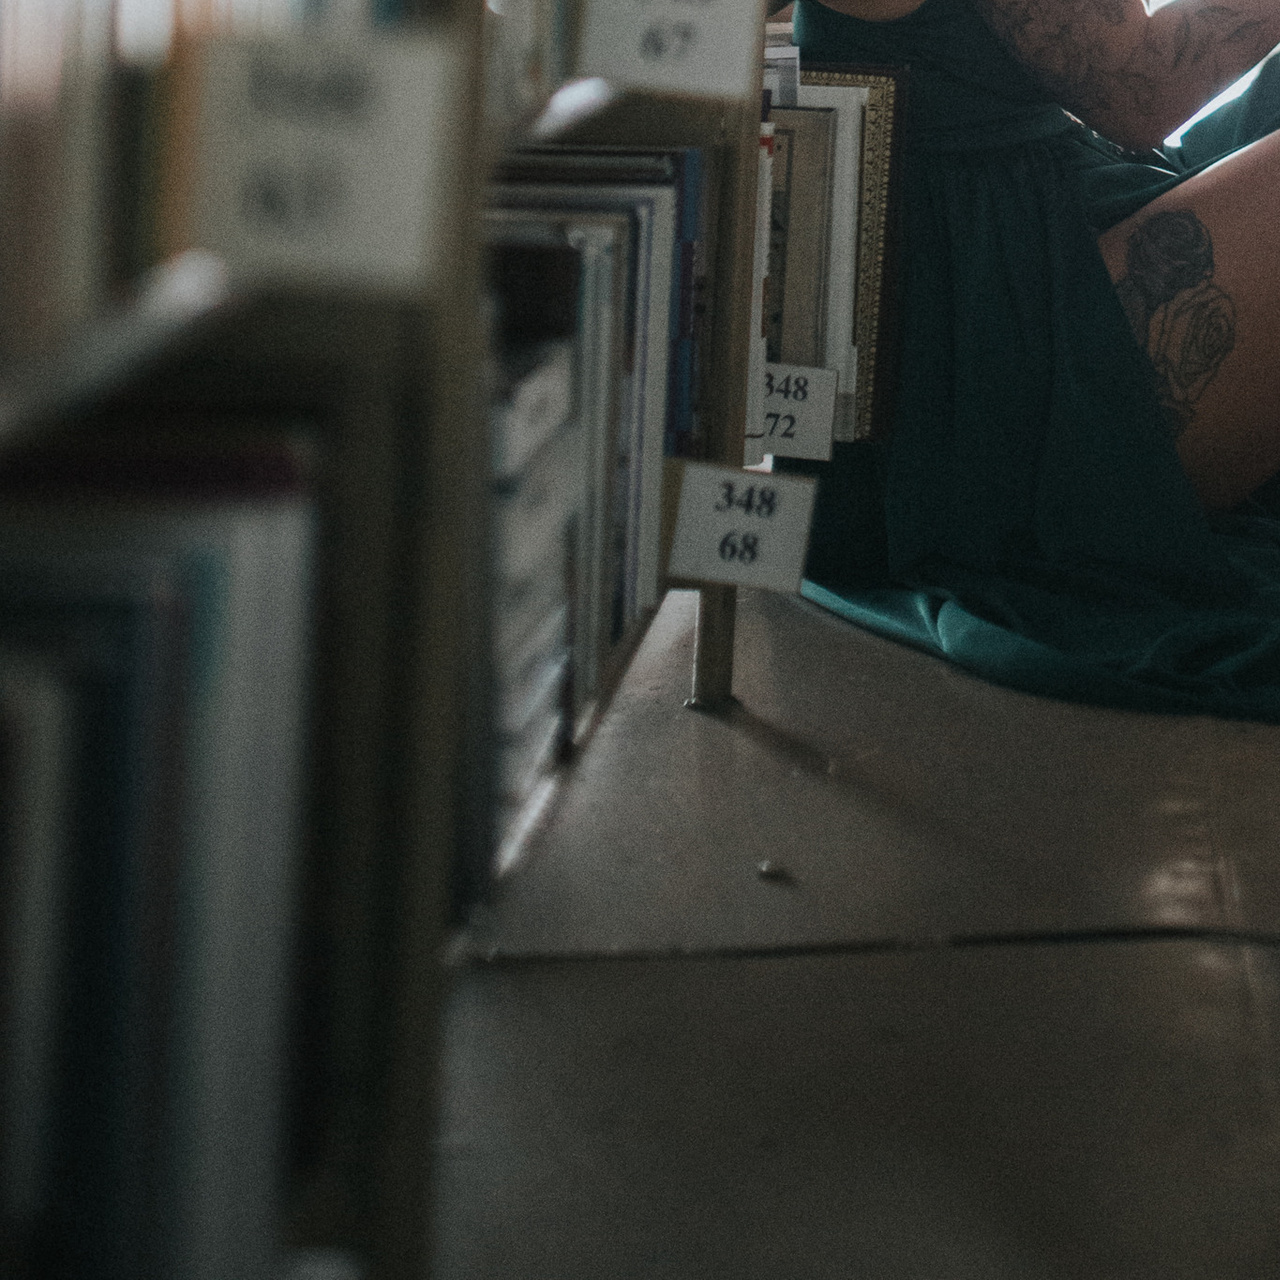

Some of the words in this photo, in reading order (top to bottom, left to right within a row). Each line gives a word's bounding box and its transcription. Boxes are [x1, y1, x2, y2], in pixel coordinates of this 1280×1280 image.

[764, 372, 809, 401] 348
[765, 412, 797, 439] 72
[714, 481, 777, 518] 348
[718, 530, 760, 565] 68
